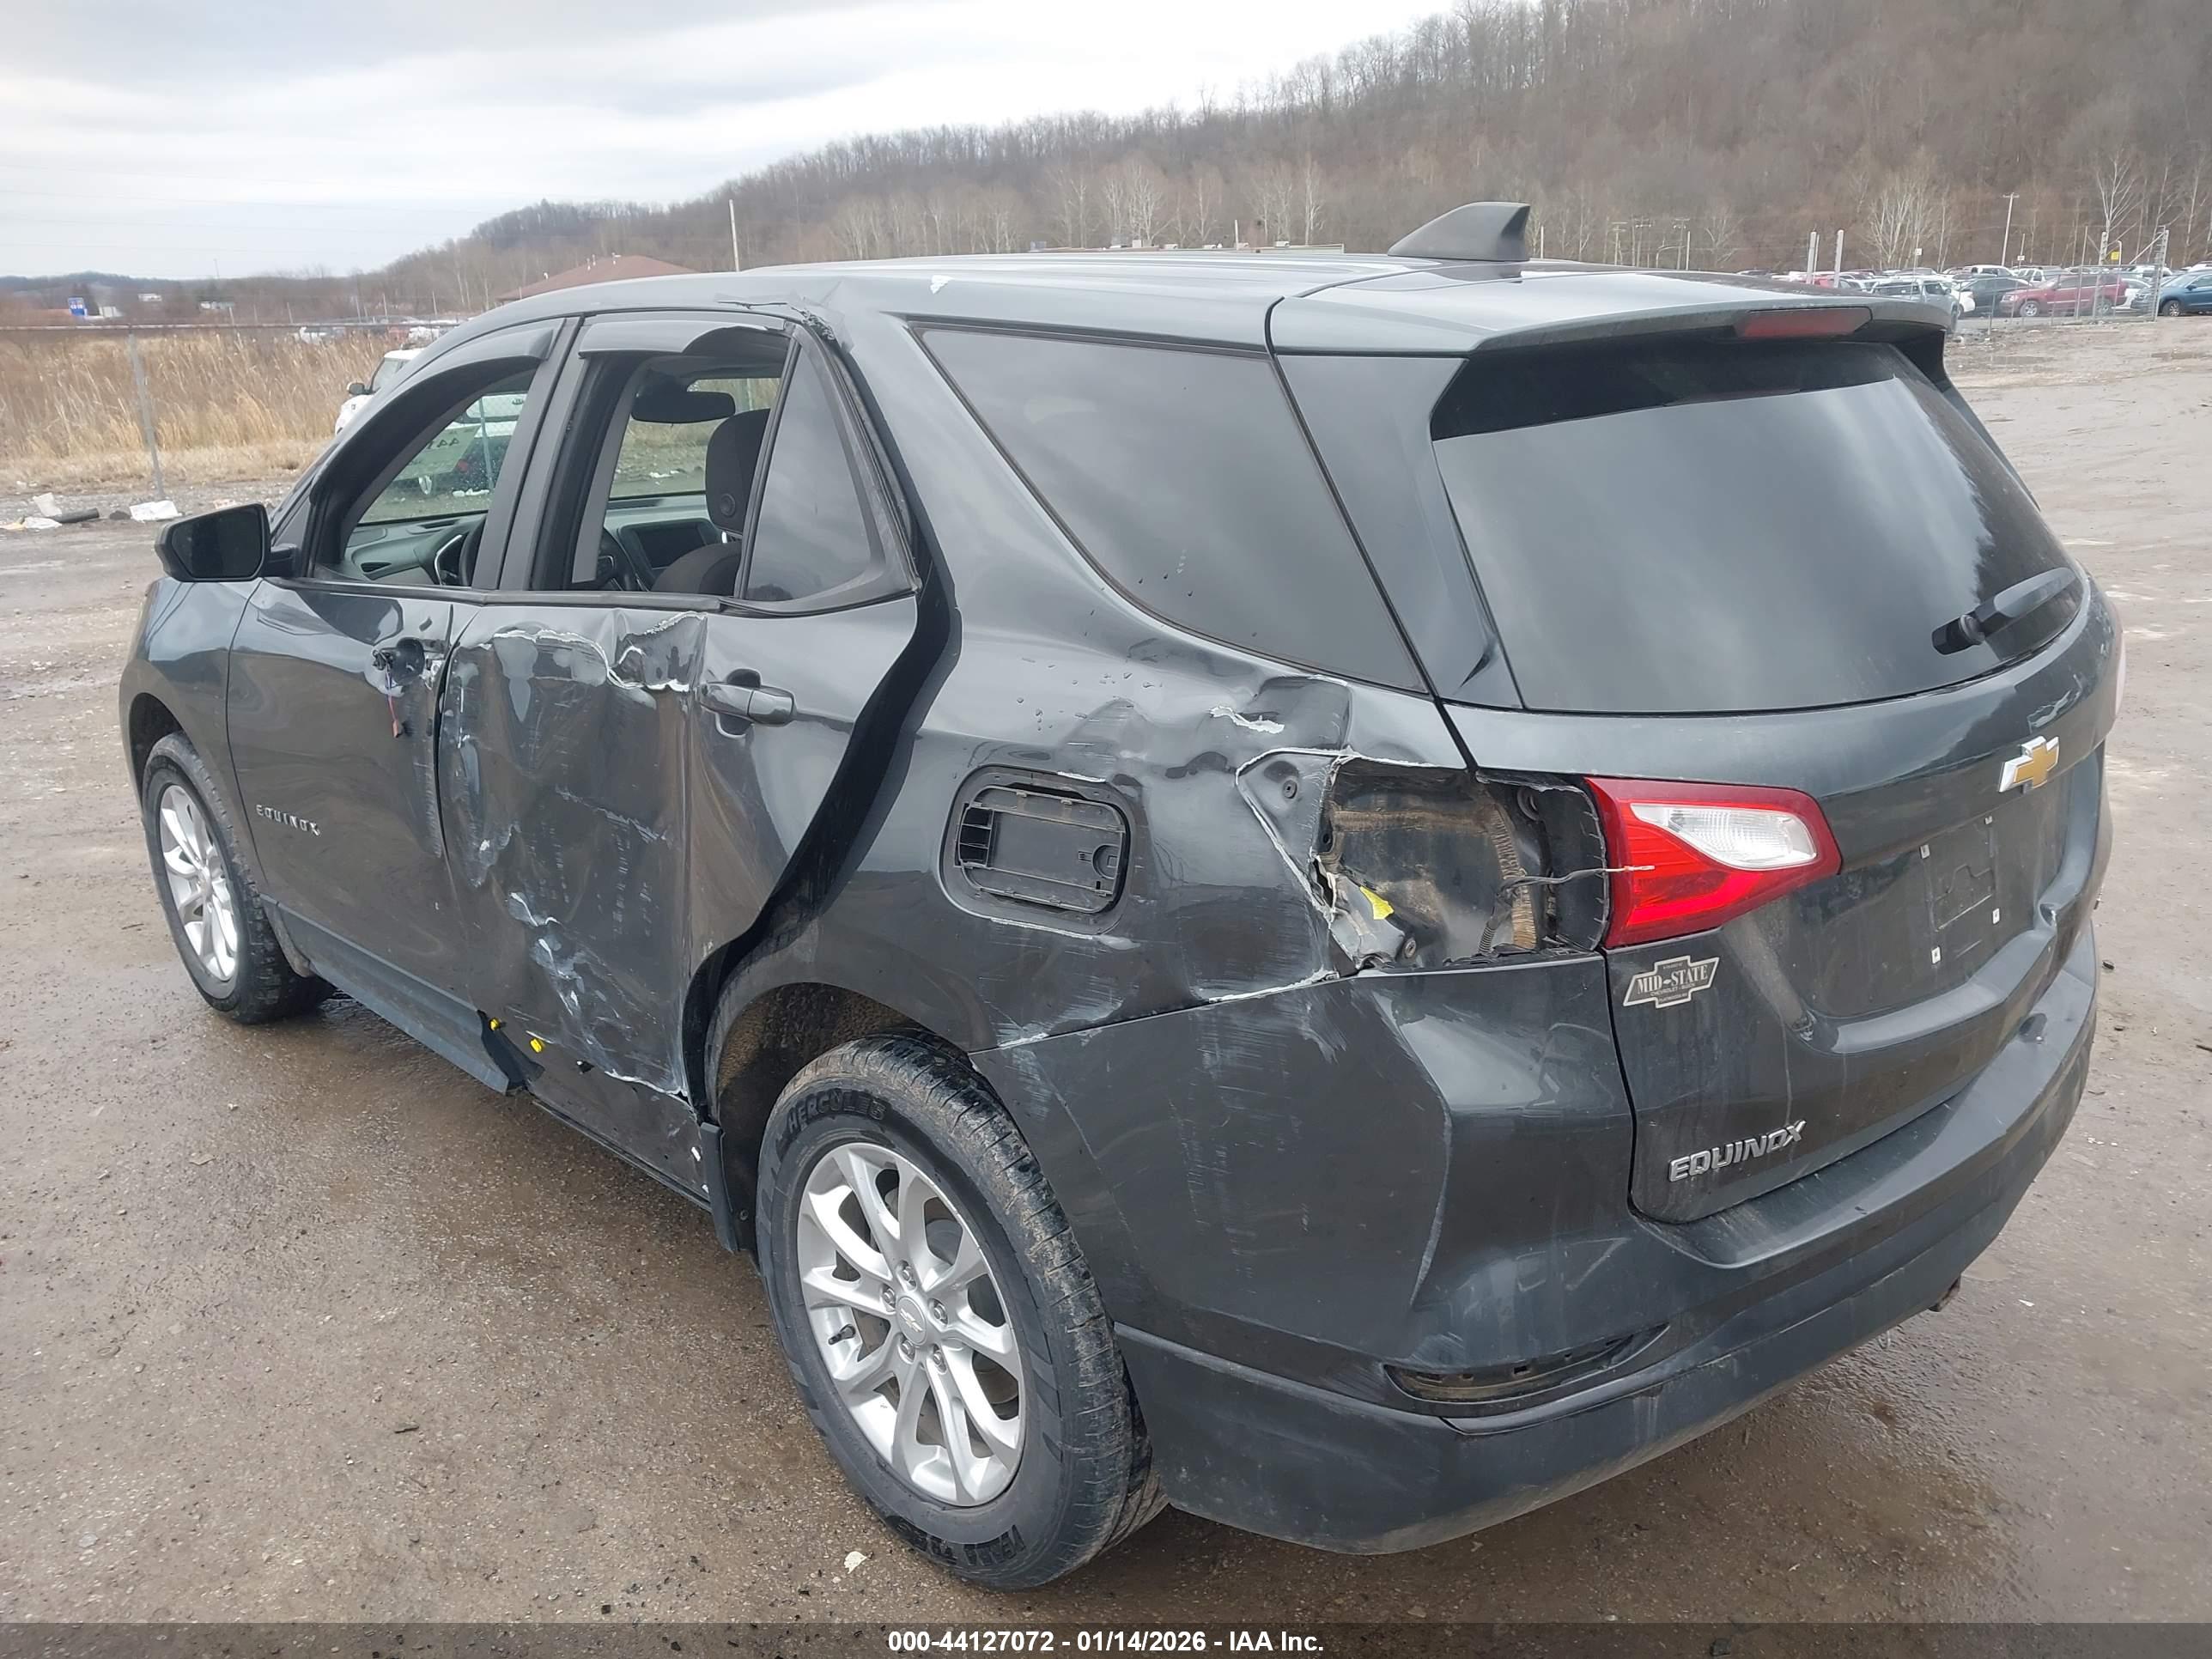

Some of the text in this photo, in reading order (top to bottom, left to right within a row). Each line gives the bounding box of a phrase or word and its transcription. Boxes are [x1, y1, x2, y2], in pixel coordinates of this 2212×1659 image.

[255, 804, 321, 836] EQUINOX
[787, 1089, 887, 1133] HERCULES
[1668, 1120, 1807, 1182] EQUINOX
